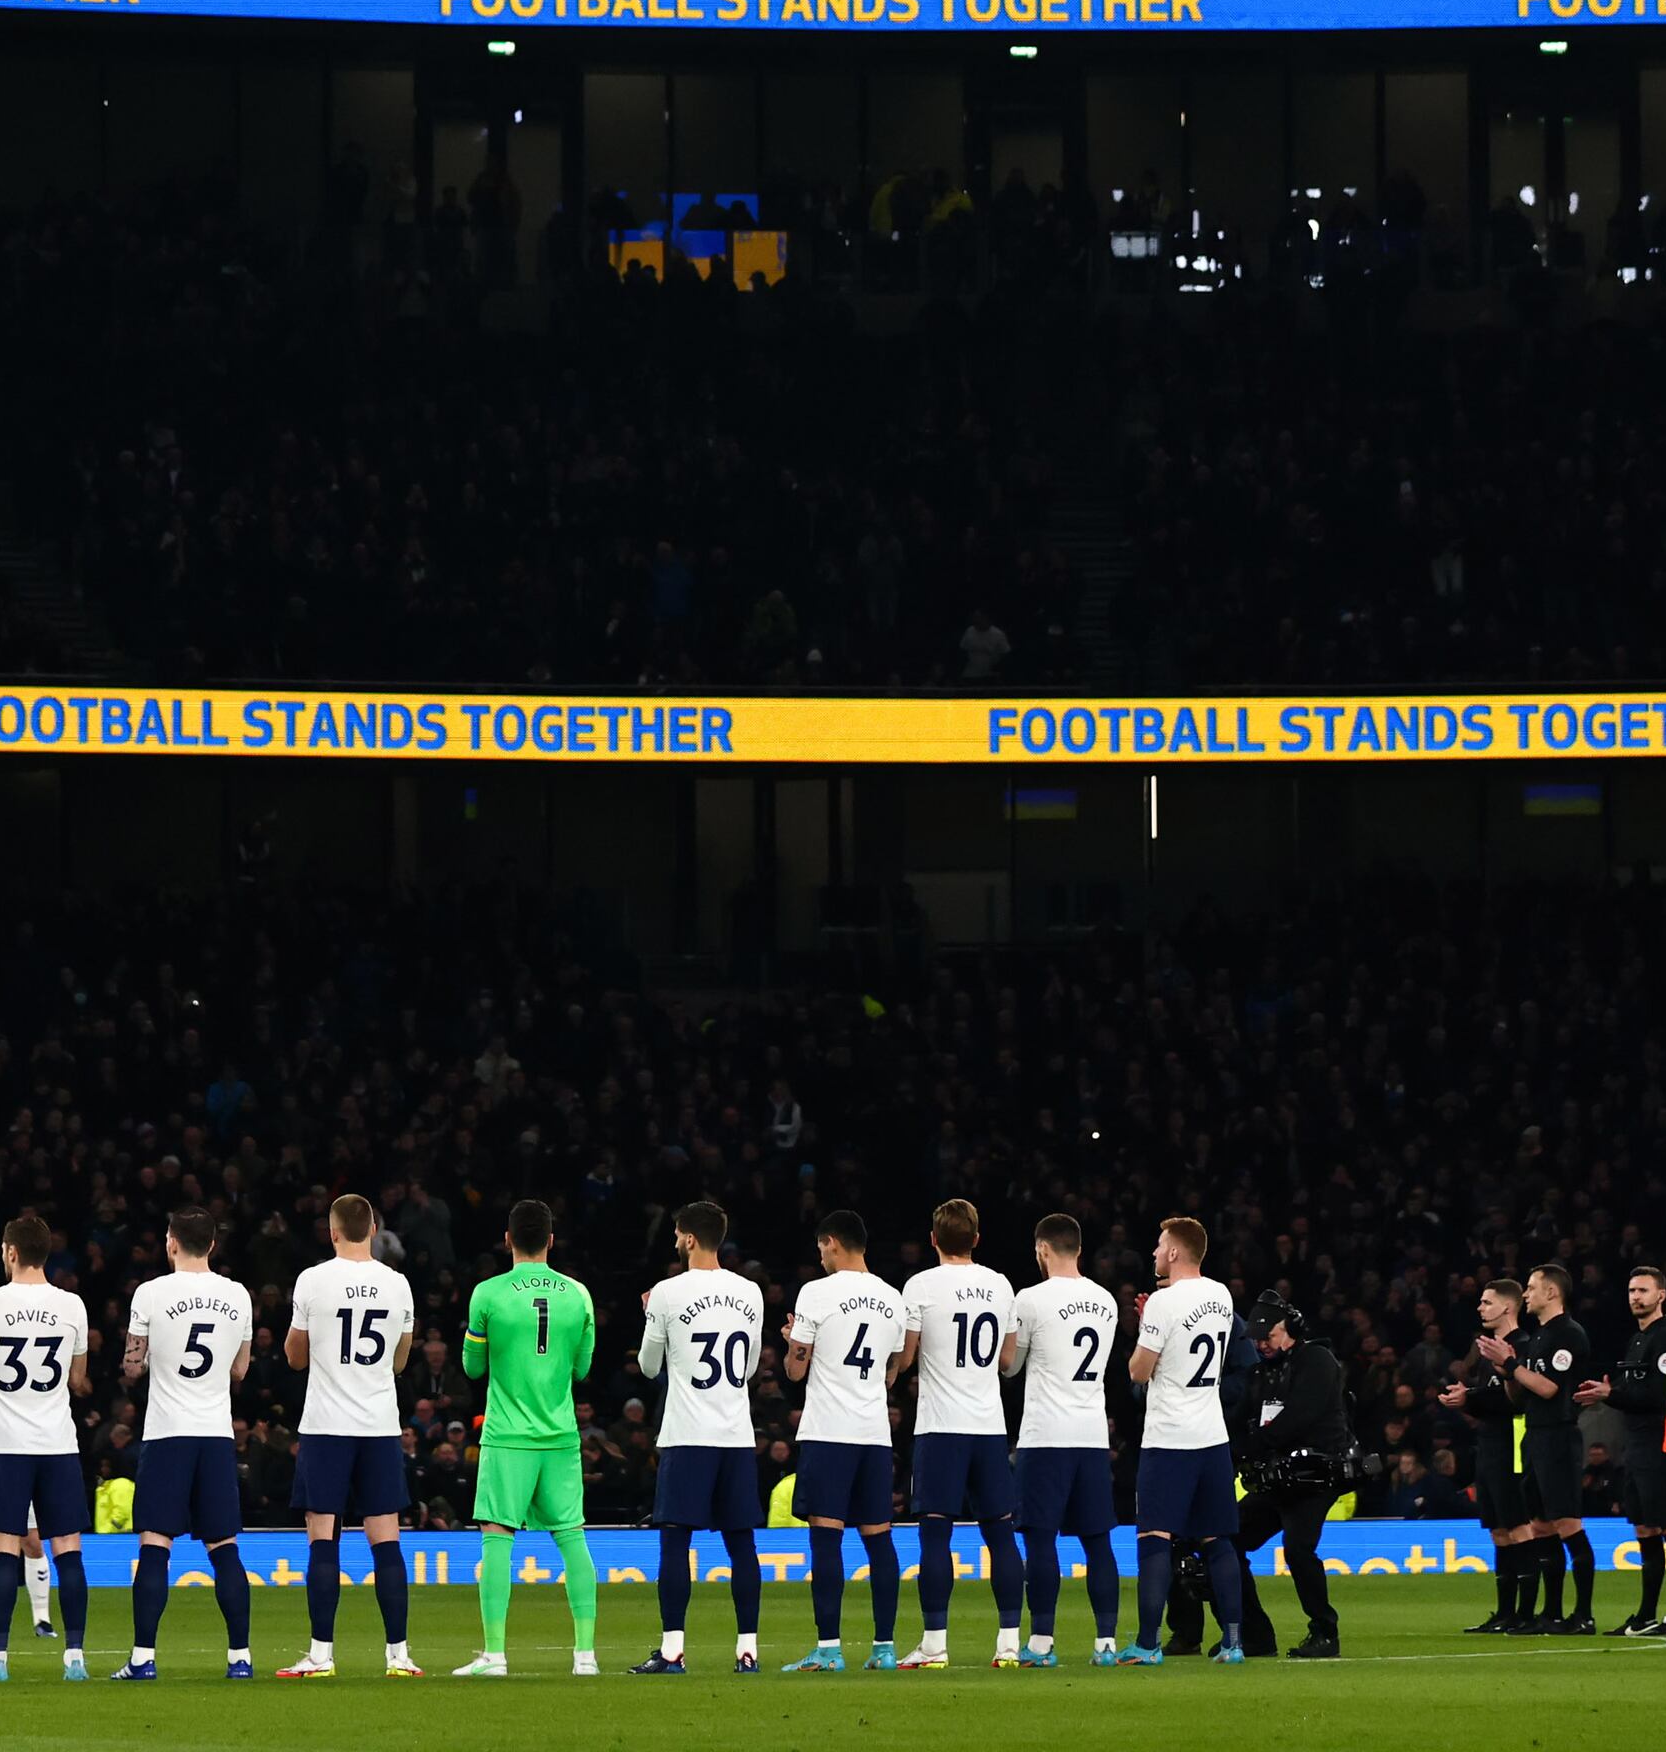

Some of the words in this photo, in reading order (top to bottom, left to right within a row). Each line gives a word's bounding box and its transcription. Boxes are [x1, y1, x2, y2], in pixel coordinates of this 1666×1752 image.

[243, 701, 446, 750] STANDS
[462, 706, 731, 752] TOGETHER
[990, 709, 1264, 753] FOOTBALL
[1281, 706, 1492, 752] STANDS
[165, 1296, 239, 1322] HØJBJERG
[345, 1285, 379, 1300] DIER
[511, 1277, 567, 1294] LLORIS
[839, 1296, 895, 1321] ROMERO
[955, 1287, 994, 1303] KANE
[4, 1309, 59, 1327] DAVIES
[532, 1298, 550, 1355] 1
[679, 1295, 757, 1326] BENTANCUR
[1058, 1303, 1114, 1324] DOHERTY
[178, 1323, 216, 1379] 5
[336, 1308, 390, 1366] 15
[690, 1330, 751, 1390] 30
[843, 1323, 875, 1380] 4
[952, 1312, 1000, 1368] 10
[1072, 1326, 1100, 1382] 2
[1185, 1331, 1227, 1388] 21
